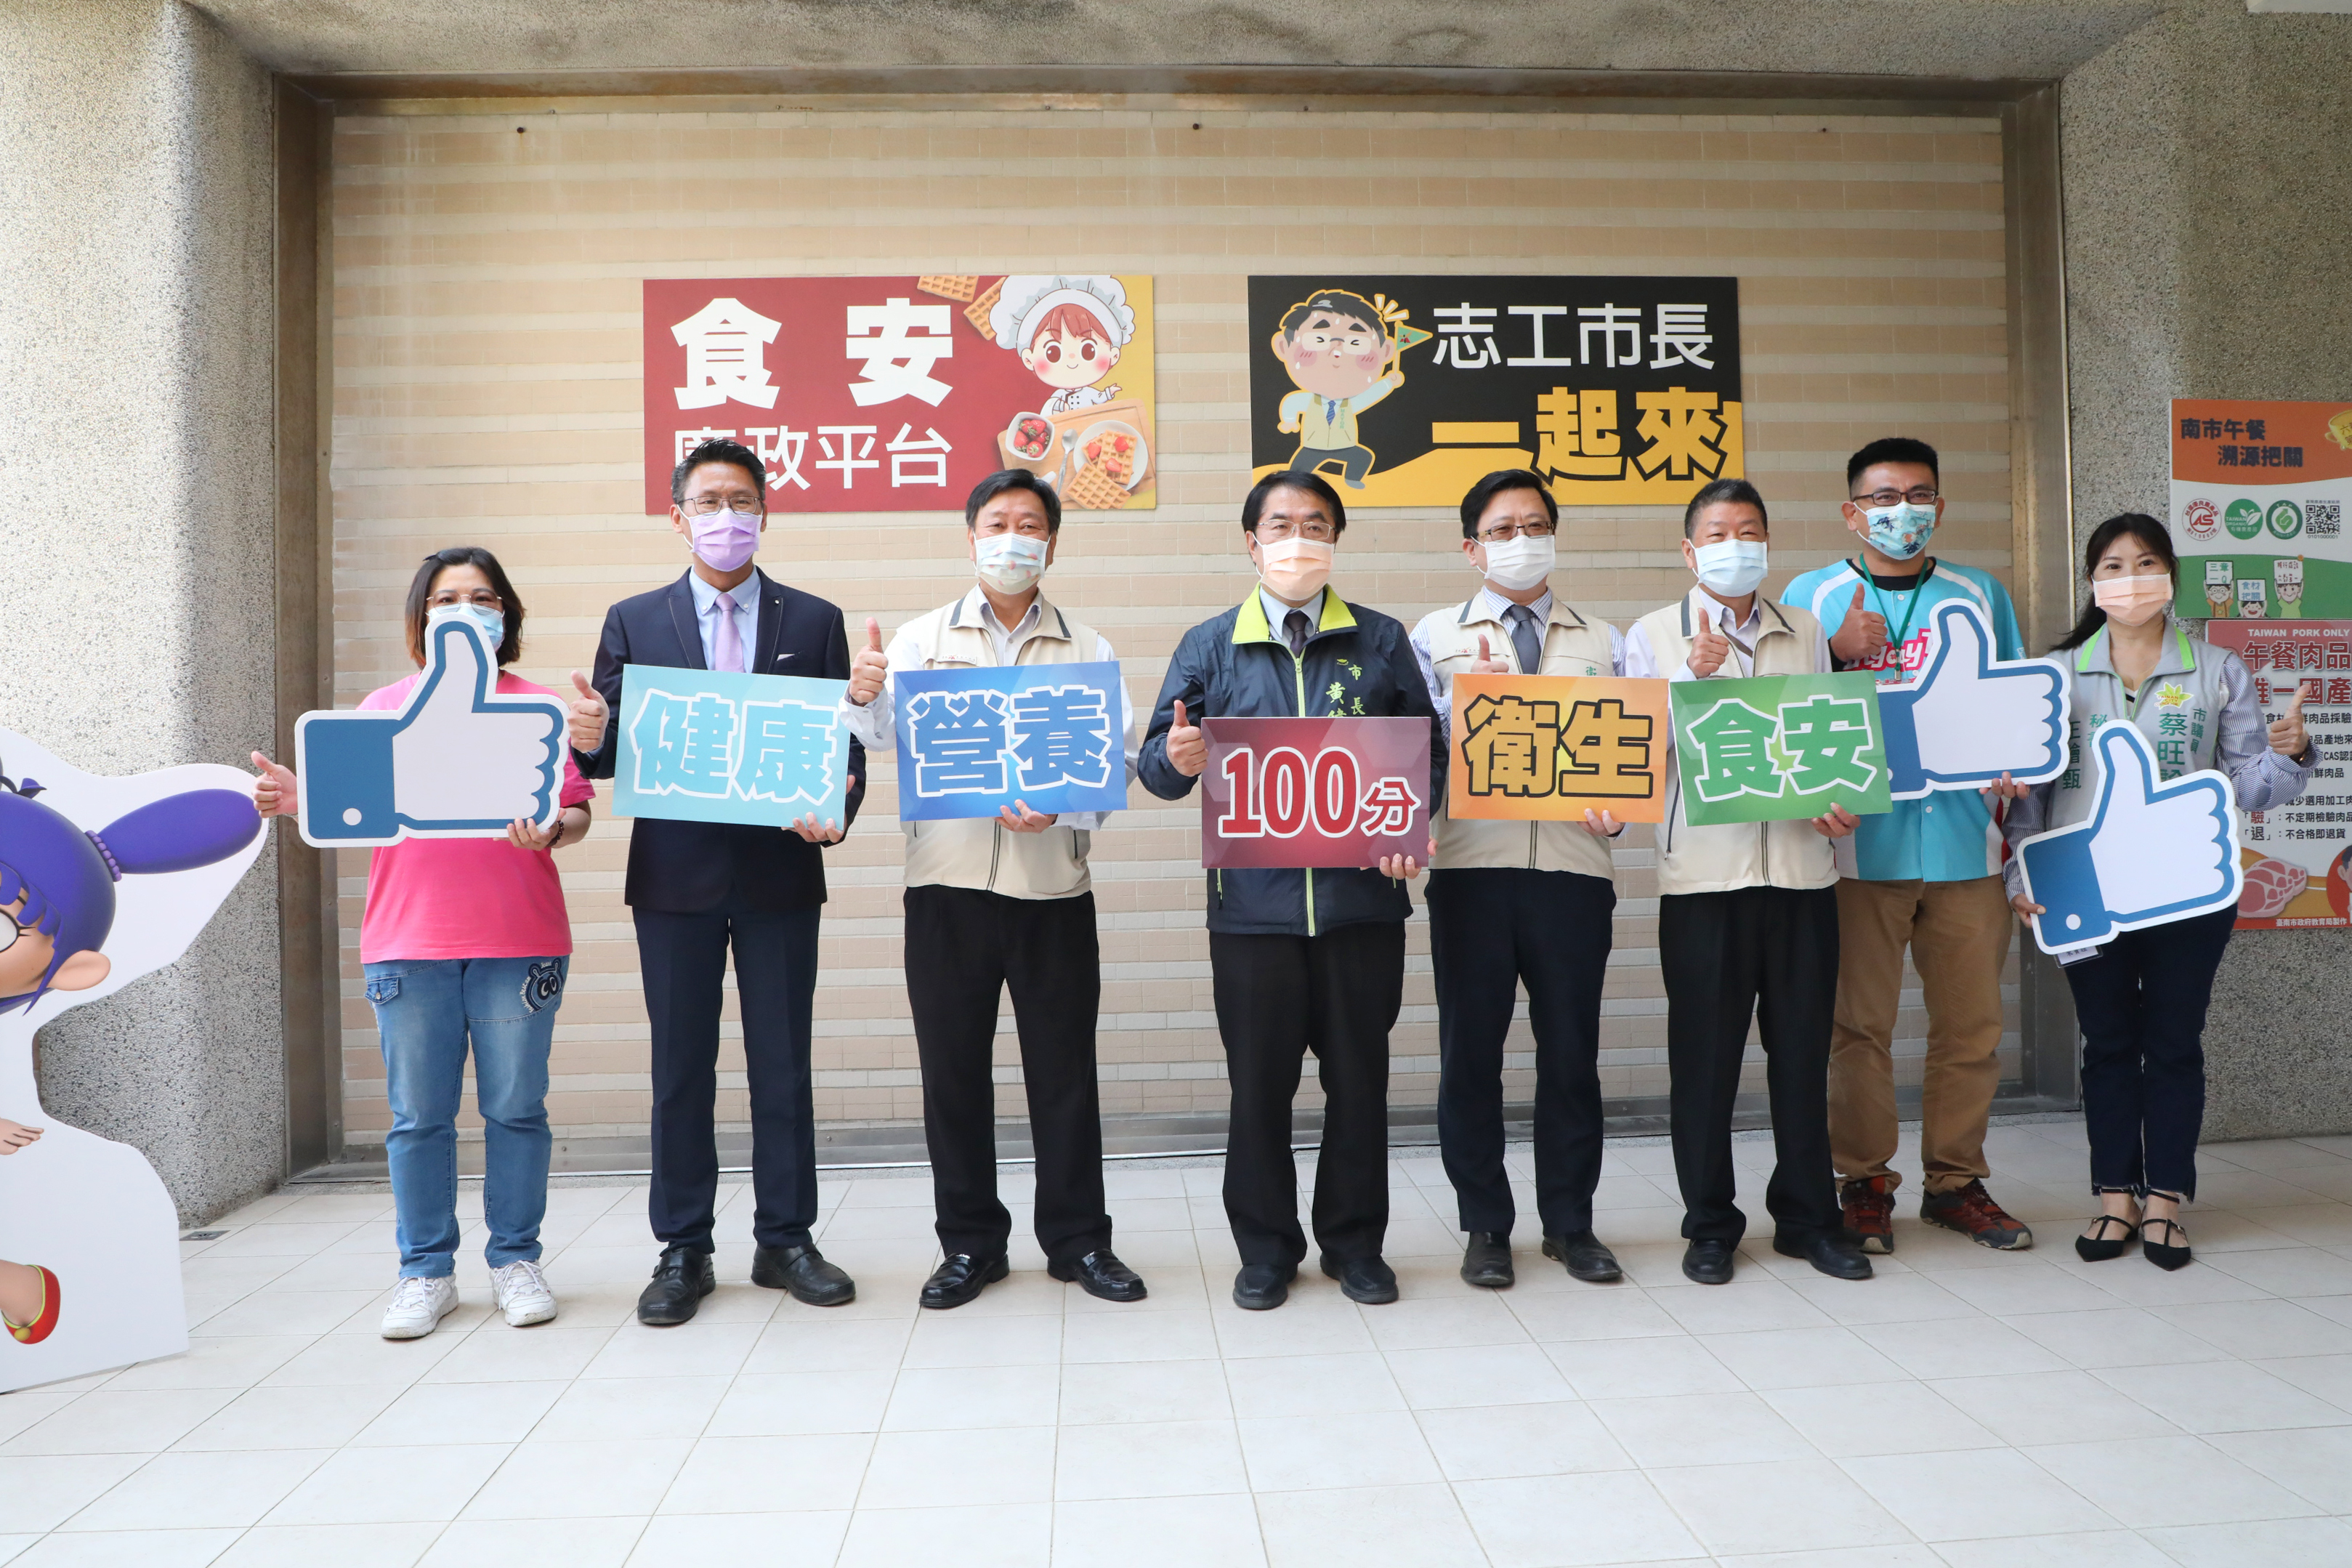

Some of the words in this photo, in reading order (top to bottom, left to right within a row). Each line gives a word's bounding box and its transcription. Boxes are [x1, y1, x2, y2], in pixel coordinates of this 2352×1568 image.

[671, 297, 953, 410] 食安
[1432, 302, 1715, 369] 志工市長
[1432, 387, 1721, 479] 一起來
[2181, 418, 2266, 440] 南市午餐
[2218, 445, 2303, 467] 溯源把關
[2210, 562, 2229, 572] 三章
[2242, 581, 2260, 590] 食材
[2242, 592, 2260, 601] 把關
[2242, 640, 2351, 671] 午餐肉品
[2247, 629, 2287, 637] TAIWAN
[629, 687, 838, 805] 健康
[908, 684, 1112, 798] 營養
[1461, 693, 1653, 799] 衛生
[1686, 694, 1878, 802] 食安
[2321, 751, 2352, 761] CAS認
[1218, 747, 1421, 838] 100分
